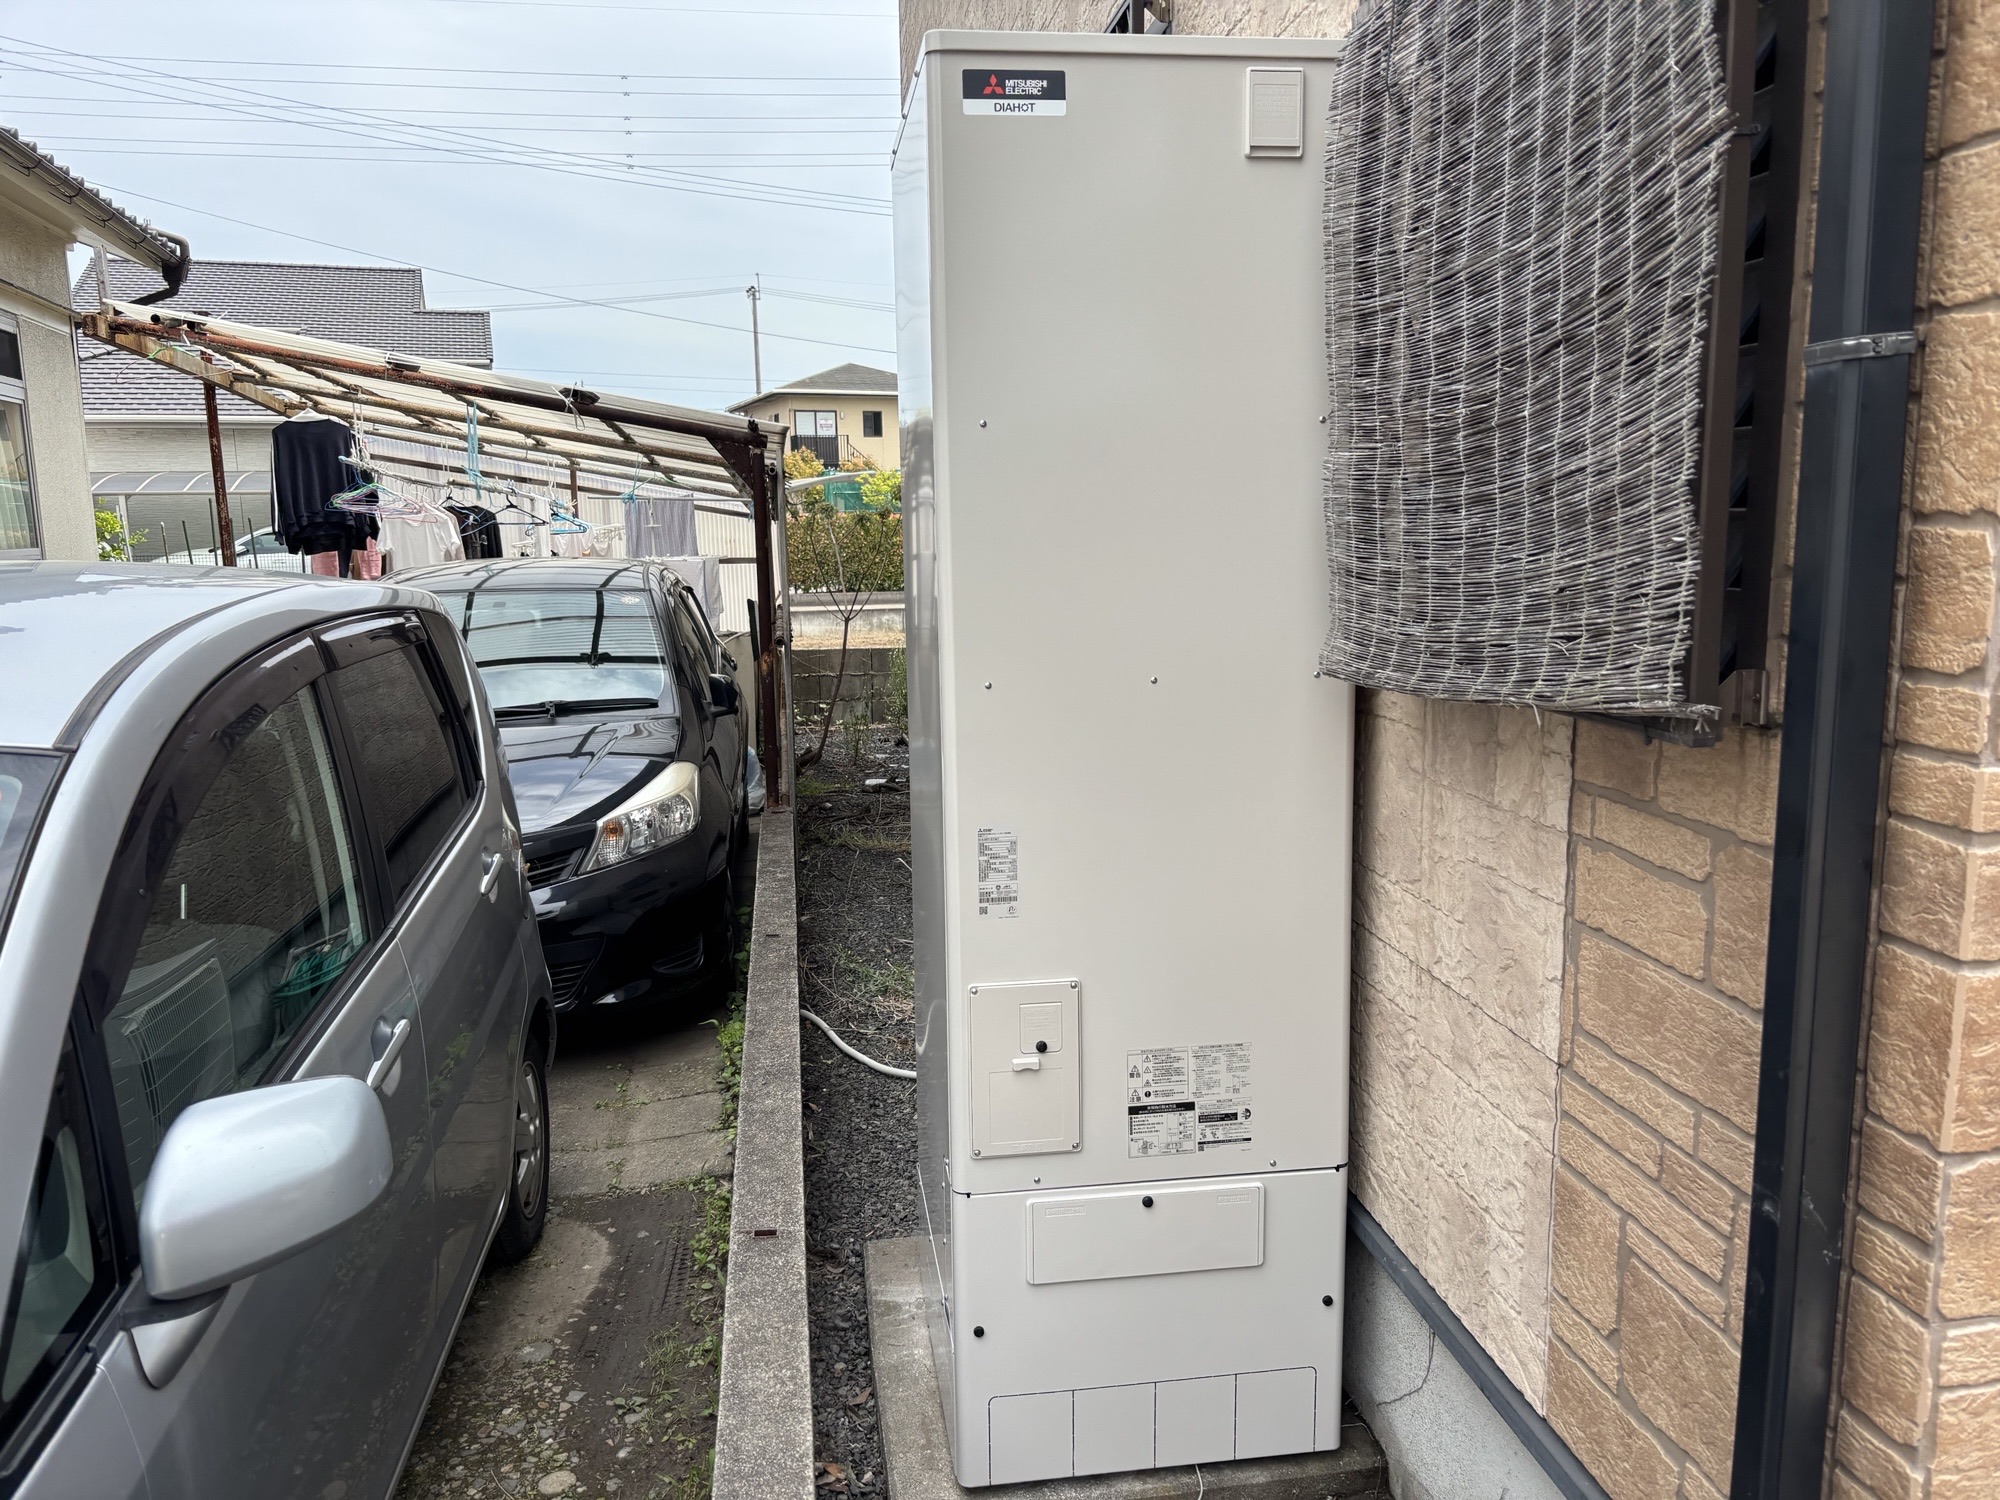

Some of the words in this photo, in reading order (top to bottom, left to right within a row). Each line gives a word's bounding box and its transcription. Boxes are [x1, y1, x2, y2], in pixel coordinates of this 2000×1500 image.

[1005, 80, 1048, 88] MITSUBISHI
[1005, 87, 1042, 95] ELECTRIC
[994, 103, 1035, 112] DIAHOT
